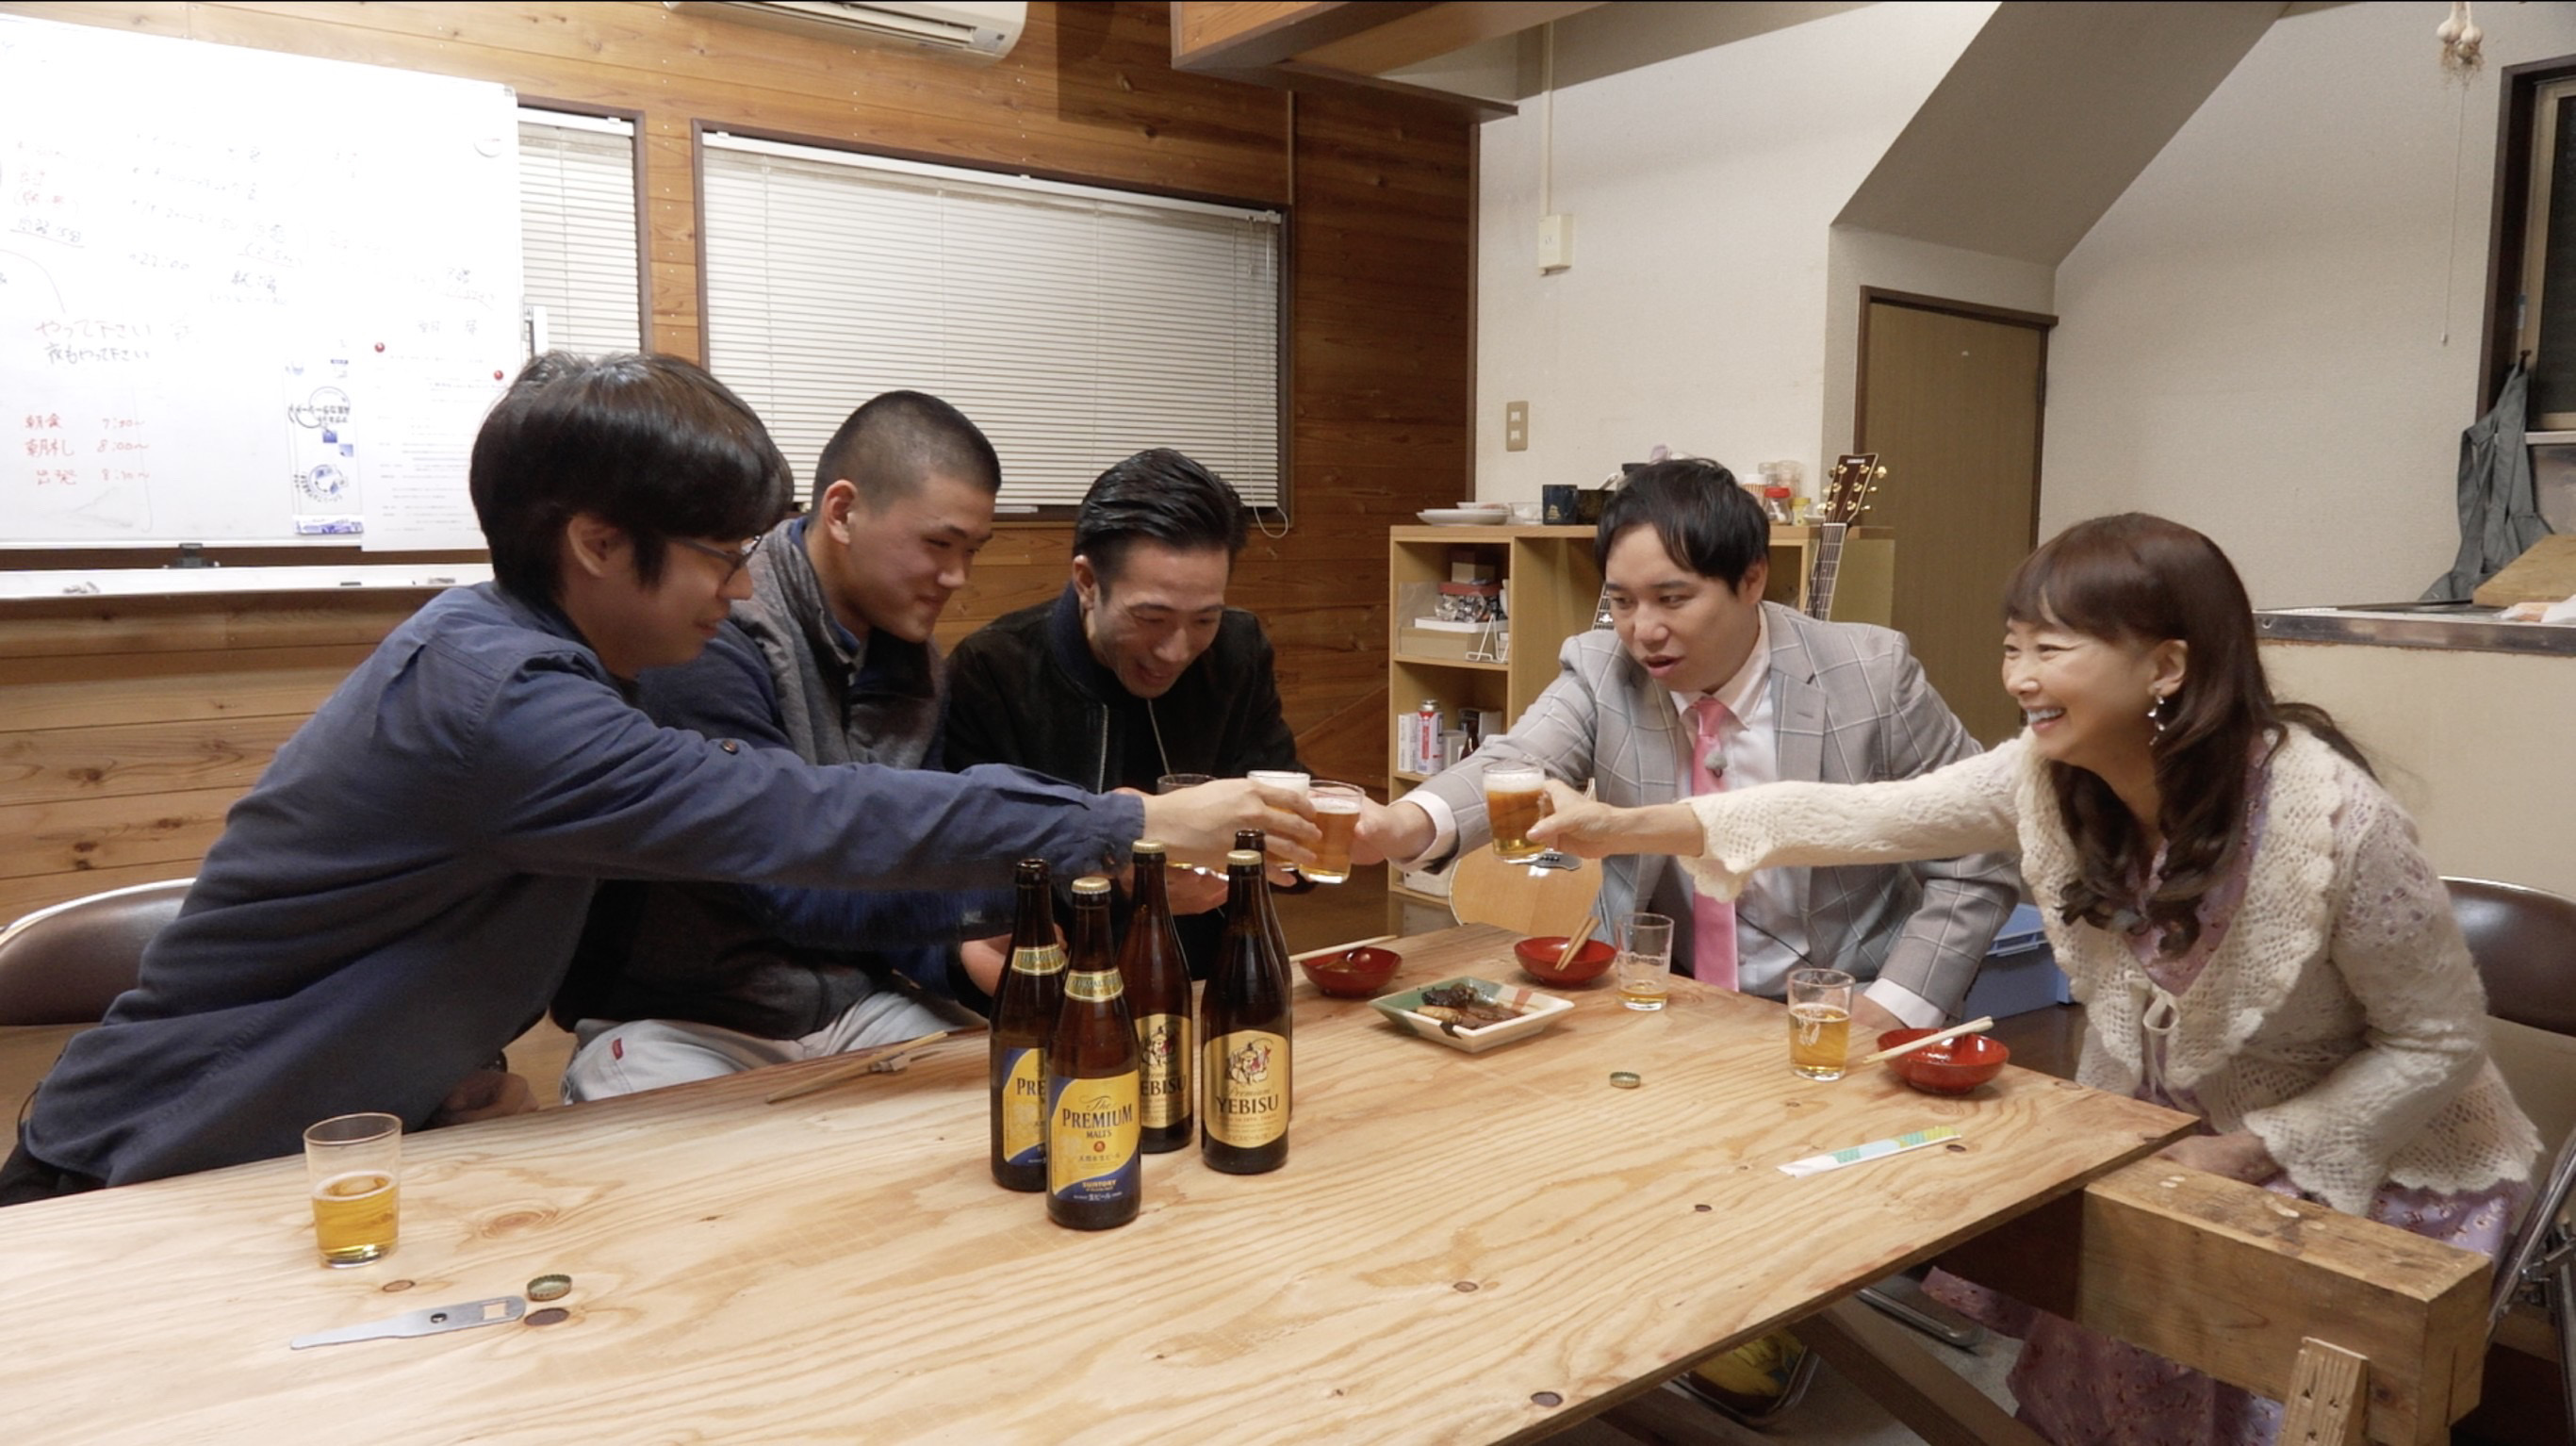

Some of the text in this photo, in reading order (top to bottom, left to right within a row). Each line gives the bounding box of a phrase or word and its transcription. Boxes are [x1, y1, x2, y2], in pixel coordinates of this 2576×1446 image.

[35, 319, 151, 338] やって下さい
[44, 342, 150, 365] 夜もやって下さい
[1140, 1075, 1187, 1095] EBISU
[1216, 1093, 1279, 1115] YEBISU
[1062, 1104, 1133, 1129] PREMIUM
